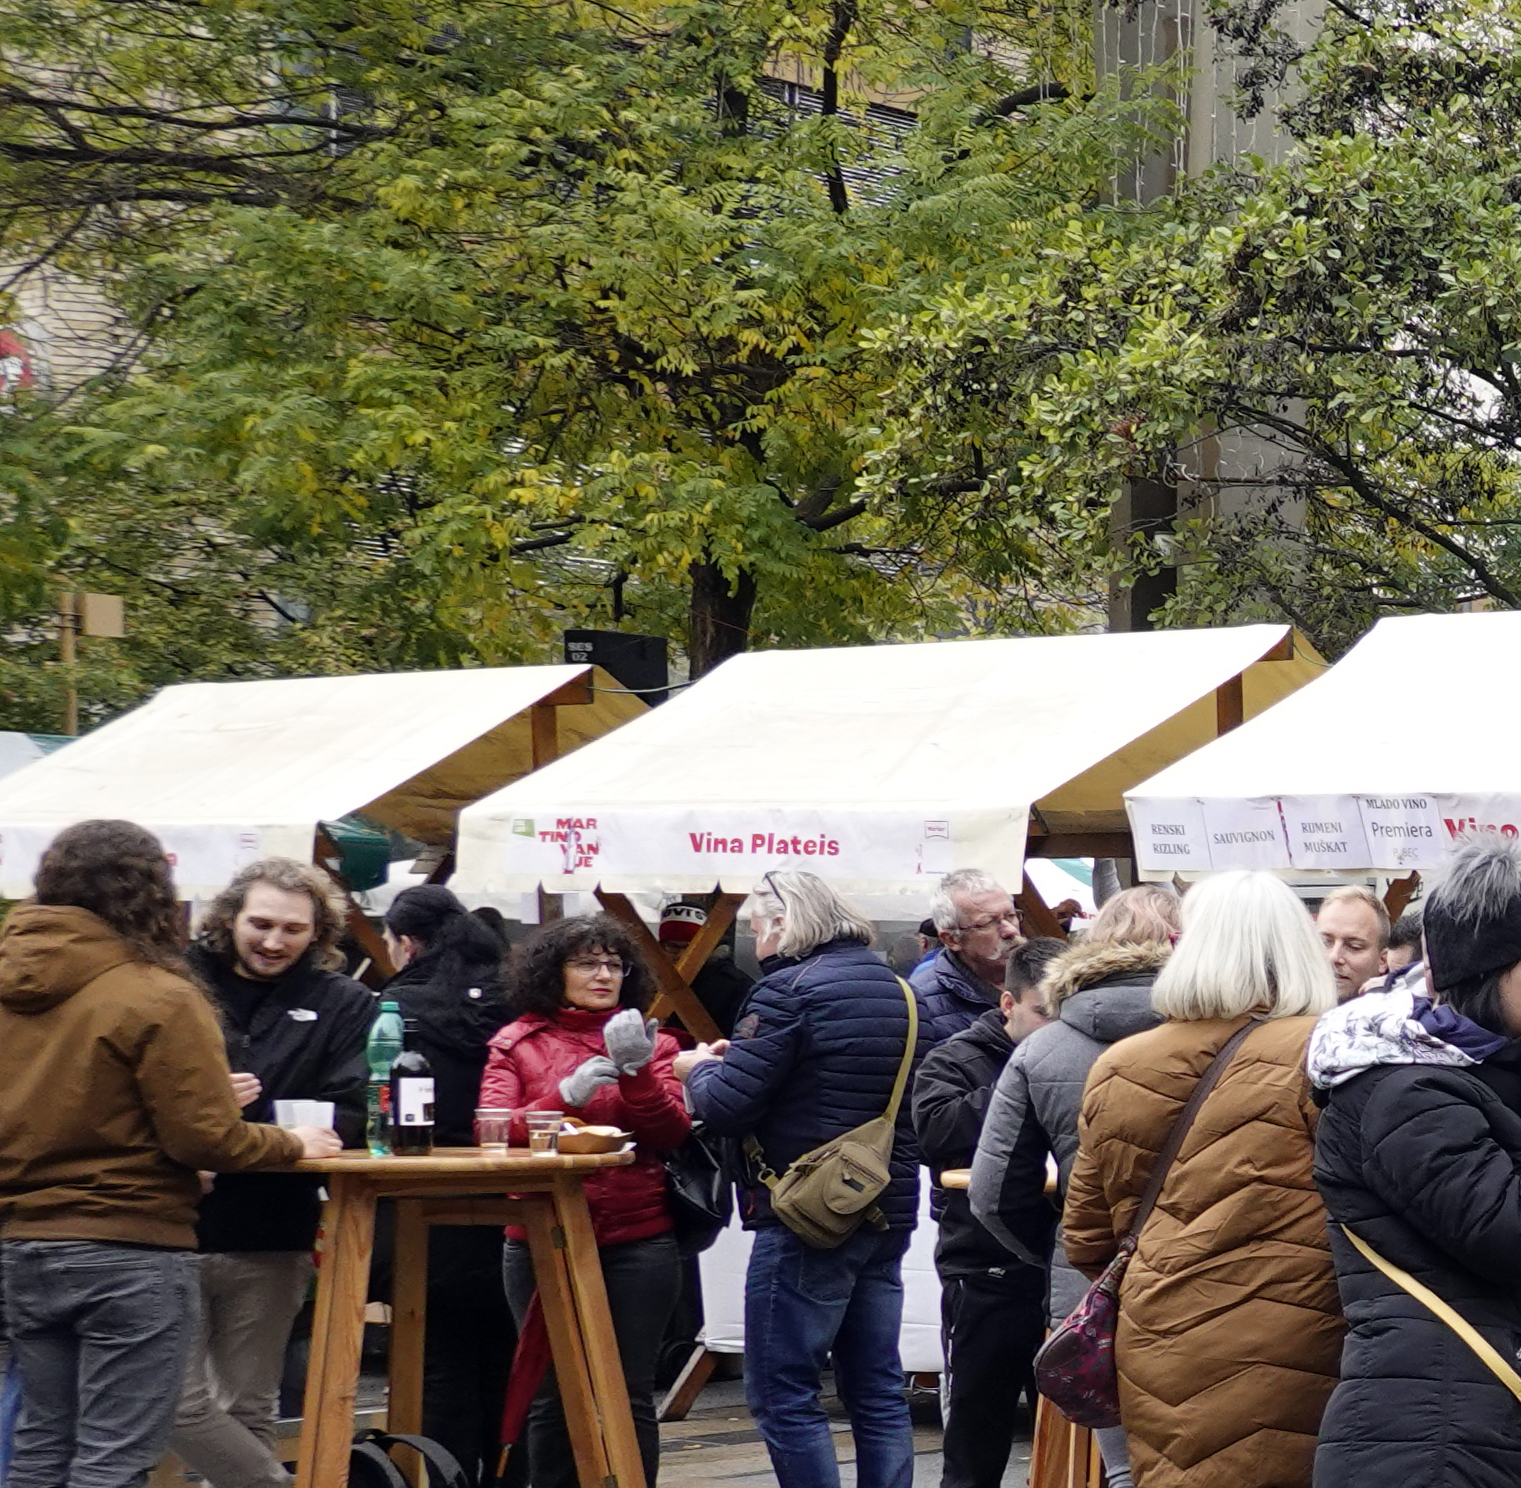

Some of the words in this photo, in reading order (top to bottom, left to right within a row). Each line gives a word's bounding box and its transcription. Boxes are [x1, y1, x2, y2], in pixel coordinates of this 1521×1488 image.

[1366, 798, 1400, 810] MLADO
[1403, 798, 1428, 810] VINO
[556, 818, 598, 830] MAR
[1151, 824, 1185, 836] RENSKI
[1301, 822, 1344, 834] RUMENI
[1371, 821, 1433, 839] Premiera
[1213, 830, 1276, 845] SAUVIGNON
[689, 832, 744, 854] Vina
[751, 833, 841, 857] Plateis
[1153, 843, 1191, 855] RIZLING
[1304, 839, 1349, 853] MUŠKAT
